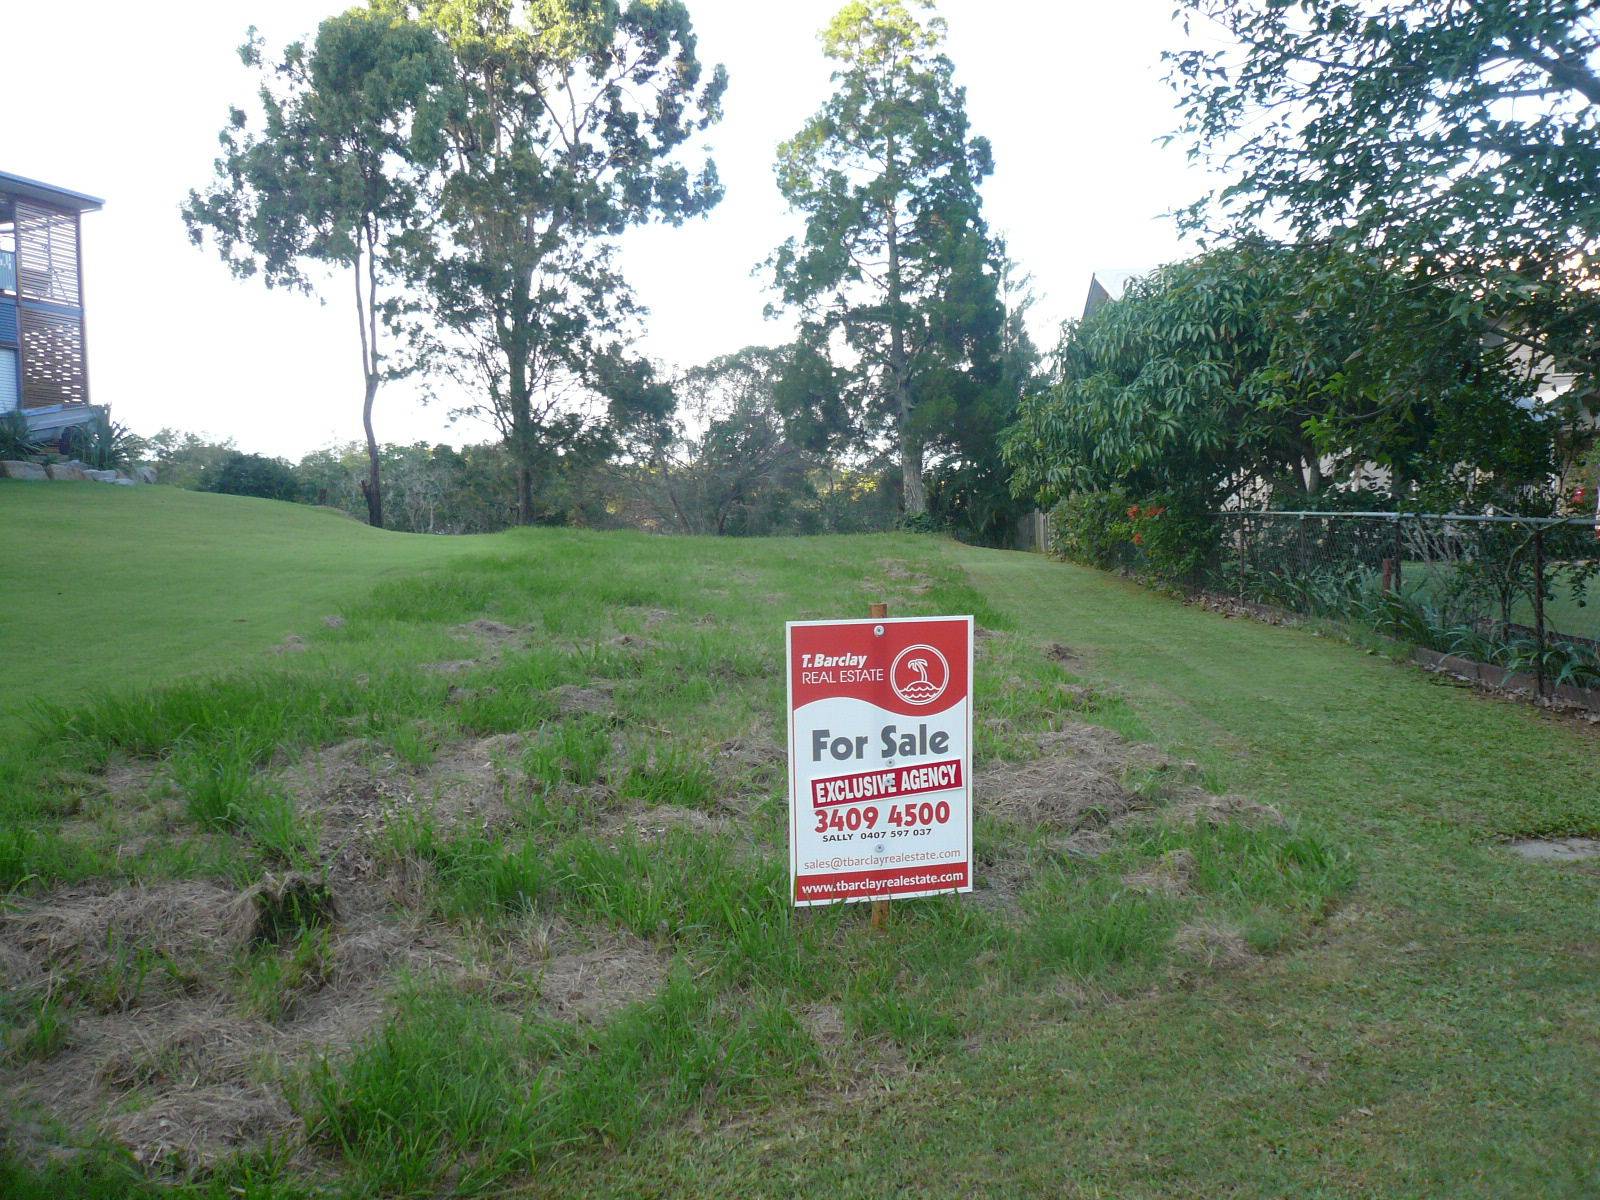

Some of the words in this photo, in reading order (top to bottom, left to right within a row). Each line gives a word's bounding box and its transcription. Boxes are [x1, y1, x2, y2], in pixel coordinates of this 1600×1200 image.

[802, 671, 837, 684] REAL
[840, 669, 884, 683] ESTATE
[812, 729, 868, 762] For
[881, 723, 950, 758] Sale
[816, 772, 897, 804] EXCLUSIVE
[901, 764, 957, 791] AGENCY
[814, 805, 879, 833] 3409
[888, 800, 950, 827] 4500
[822, 833, 854, 843] SALLY
[860, 831, 886, 840] 0407
[890, 829, 909, 838] 597
[913, 828, 932, 836] 037
[804, 849, 961, 870] sales@tbarclayrealestate.com
[802, 871, 964, 894] www.tbarclayrealestate.com
